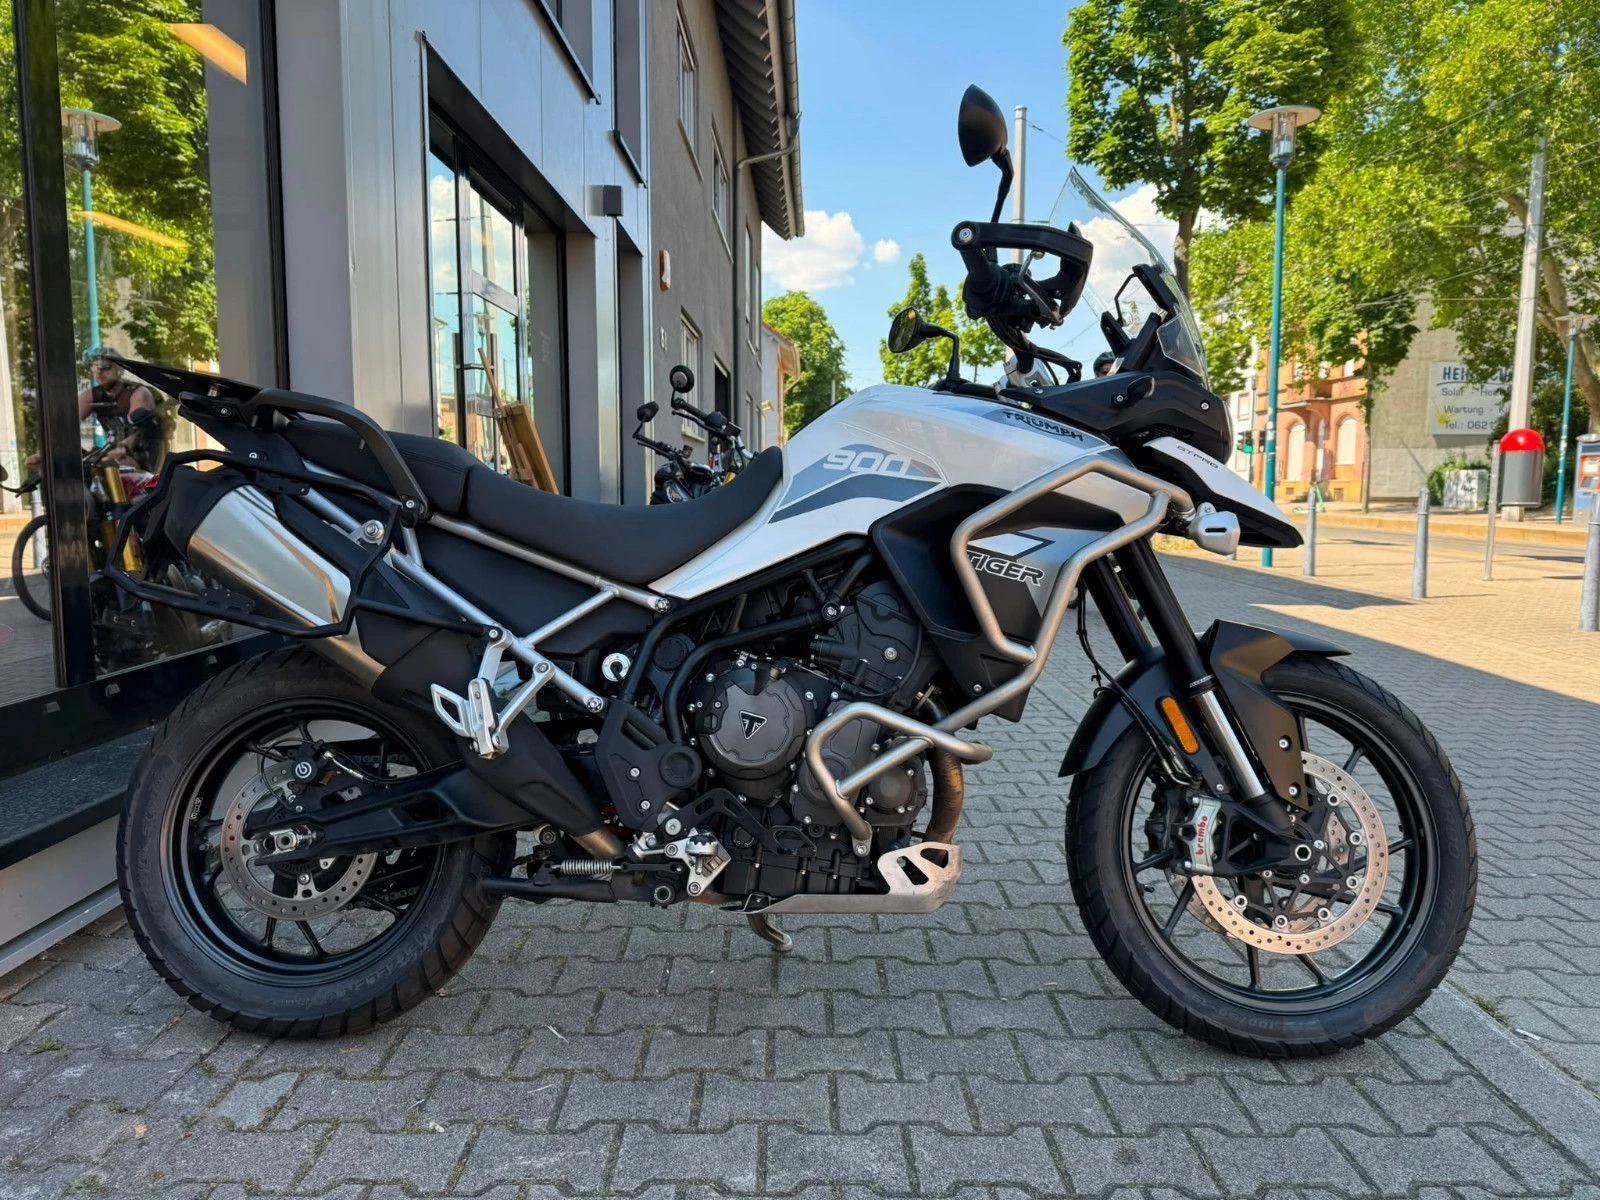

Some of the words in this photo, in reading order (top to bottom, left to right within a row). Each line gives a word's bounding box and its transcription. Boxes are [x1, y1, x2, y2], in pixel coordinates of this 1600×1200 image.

[1002, 410, 1084, 442] TRIUMPH
[1444, 404, 1484, 416] Wartung
[822, 449, 912, 475] 900
[966, 549, 1045, 587] TIGER
[1195, 815, 1209, 856] brembo
